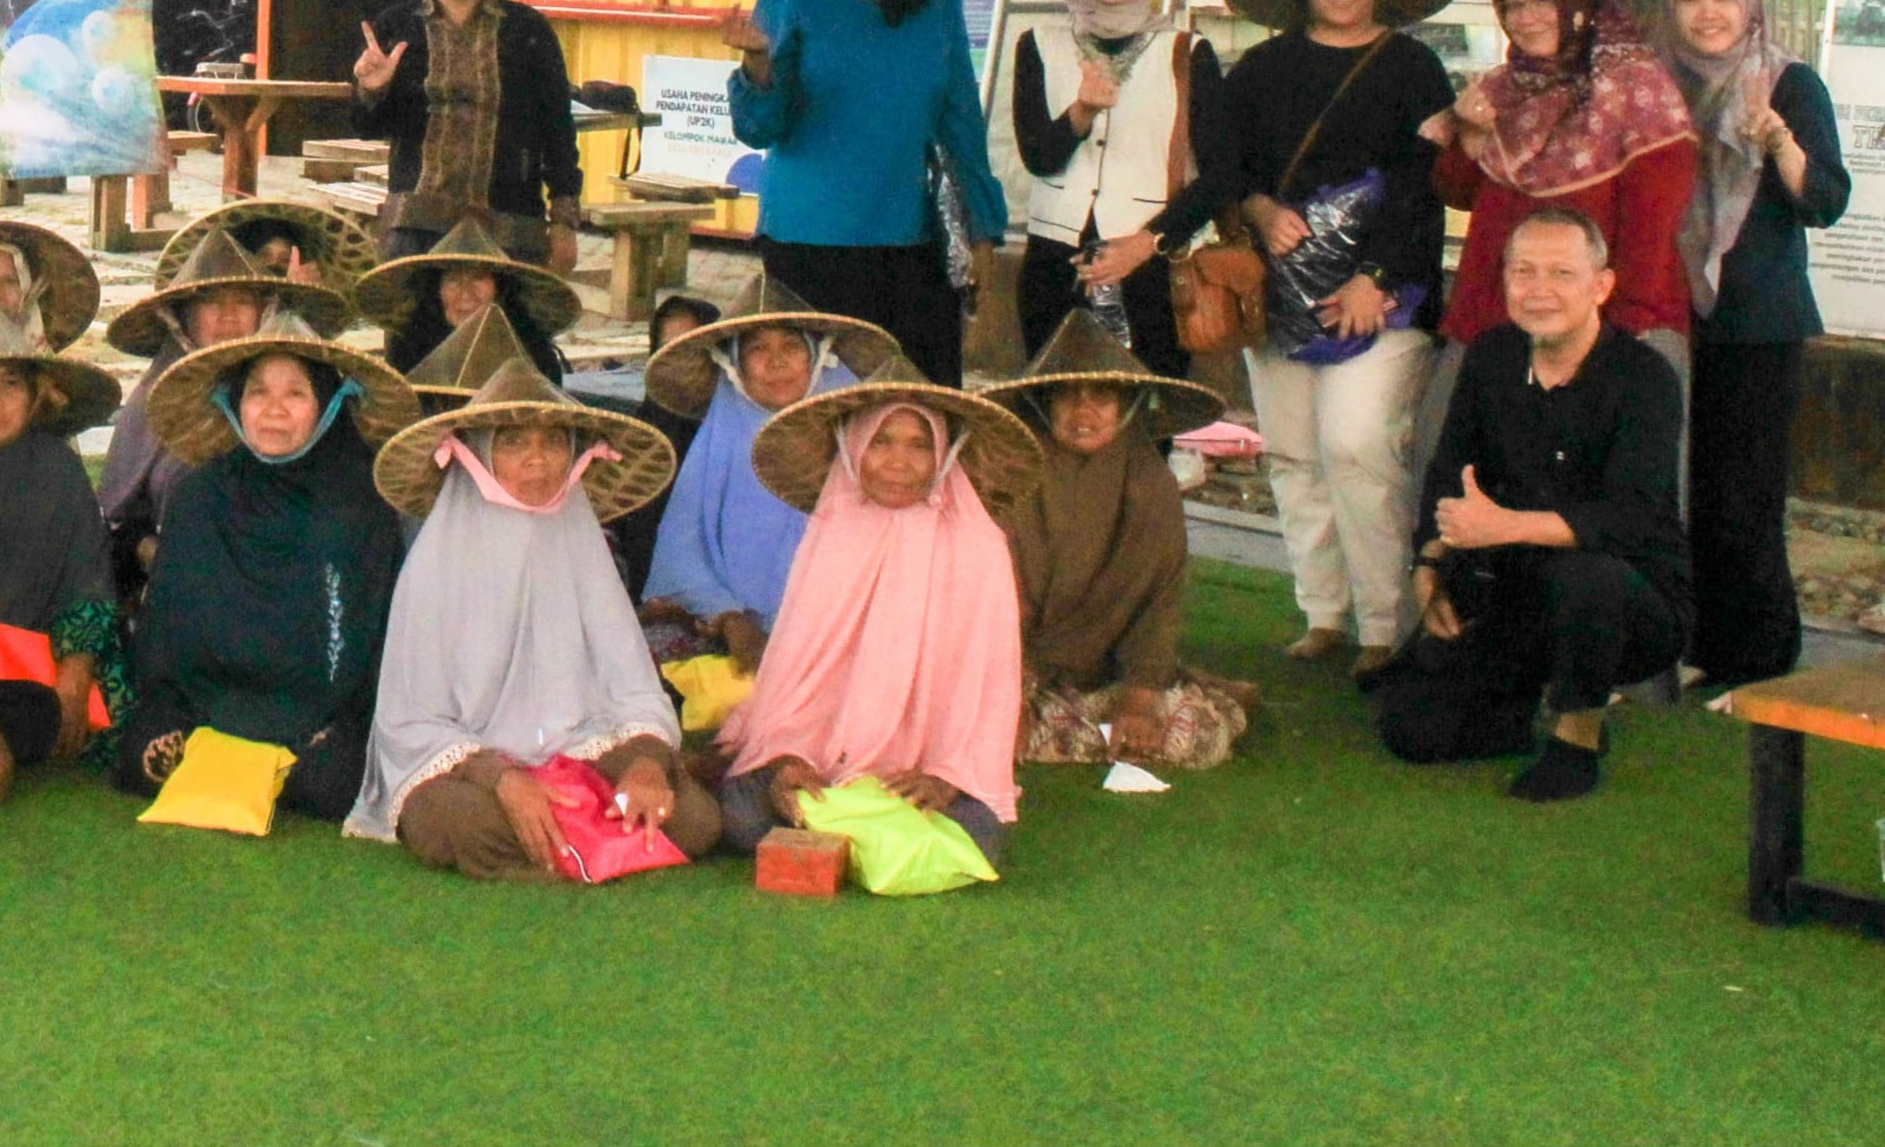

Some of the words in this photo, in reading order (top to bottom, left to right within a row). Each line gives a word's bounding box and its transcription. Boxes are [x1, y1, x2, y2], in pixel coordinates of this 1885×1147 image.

[661, 89, 688, 99] USAHA
[655, 101, 708, 114] PENDAPATAN
[687, 116, 715, 129] (UP2K)
[664, 131, 705, 143] KELOMPOK
